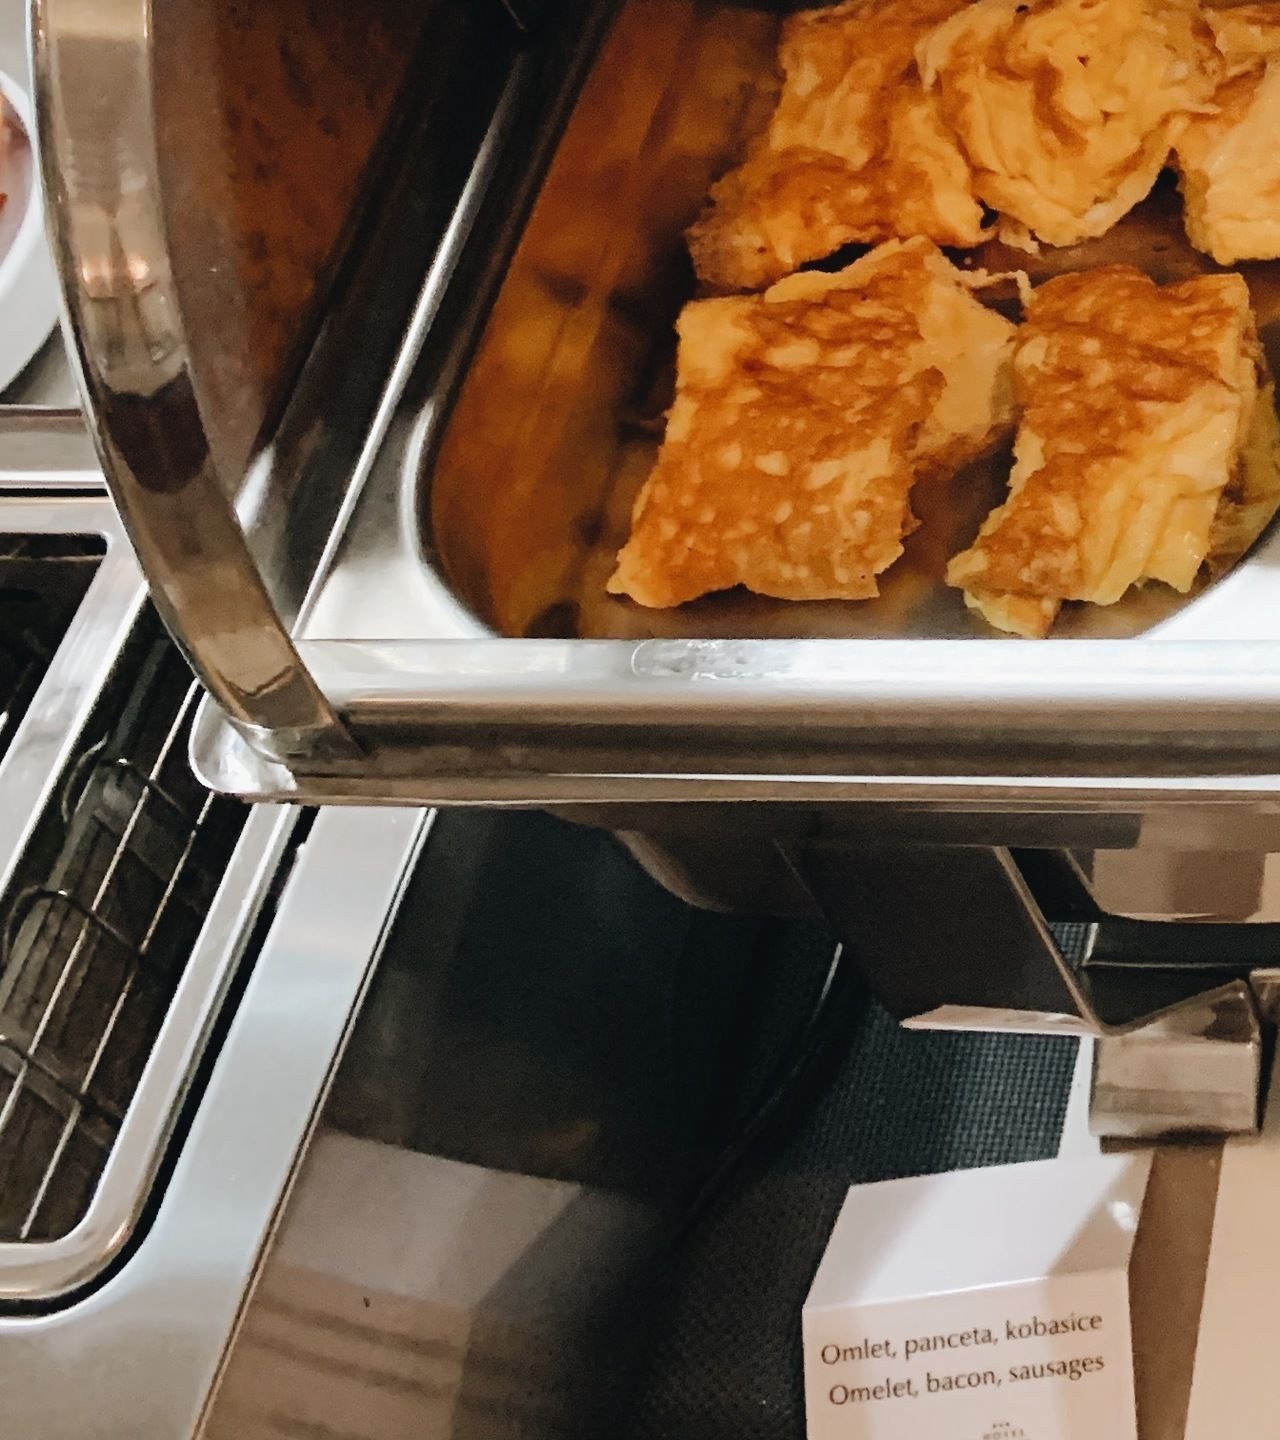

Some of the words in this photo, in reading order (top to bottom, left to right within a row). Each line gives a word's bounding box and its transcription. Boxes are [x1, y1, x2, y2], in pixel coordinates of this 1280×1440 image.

[821, 1338, 897, 1365] Omlet,
[904, 1327, 998, 1360] panceta,
[1005, 1312, 1103, 1340] kobasice
[829, 1379, 919, 1405] Omelet,
[926, 1371, 1002, 1394] bacon,
[1008, 1354, 1105, 1380] sausages
